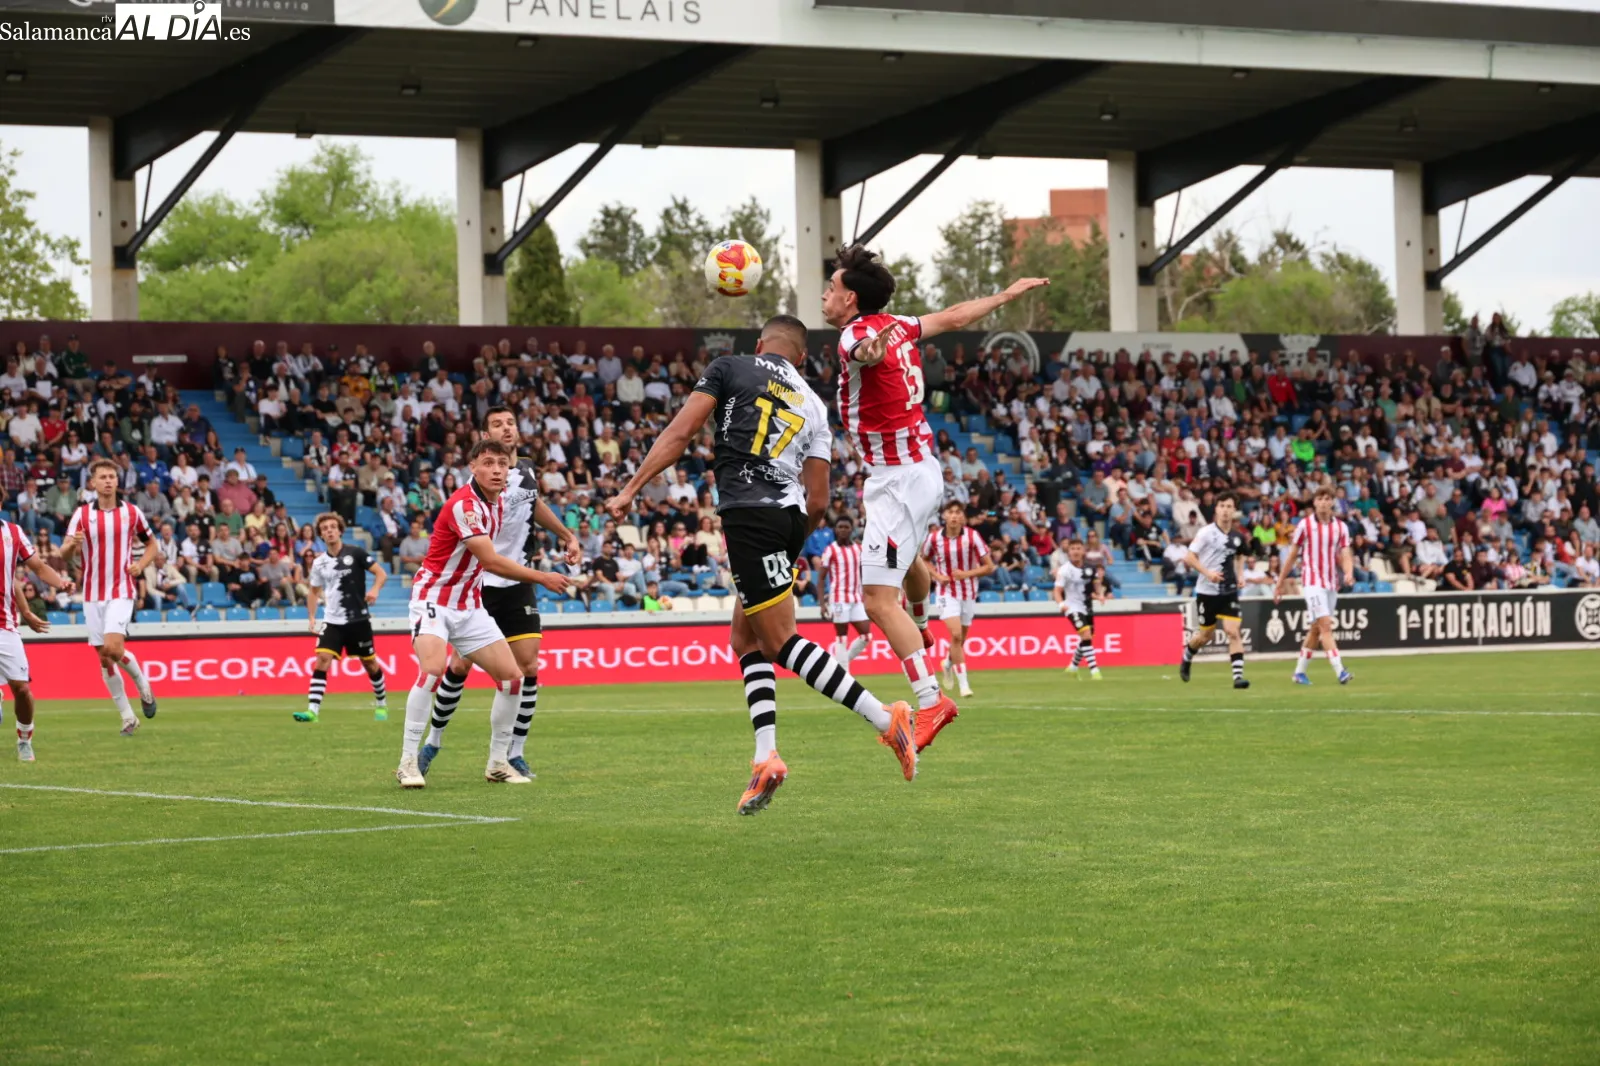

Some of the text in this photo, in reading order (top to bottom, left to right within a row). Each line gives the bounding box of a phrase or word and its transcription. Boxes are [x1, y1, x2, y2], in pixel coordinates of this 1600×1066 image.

[750, 396, 806, 459] 17
[426, 601, 437, 619] 5
[1284, 608, 1369, 631] VESUS
[1423, 596, 1552, 640] FEDERACIÓN
